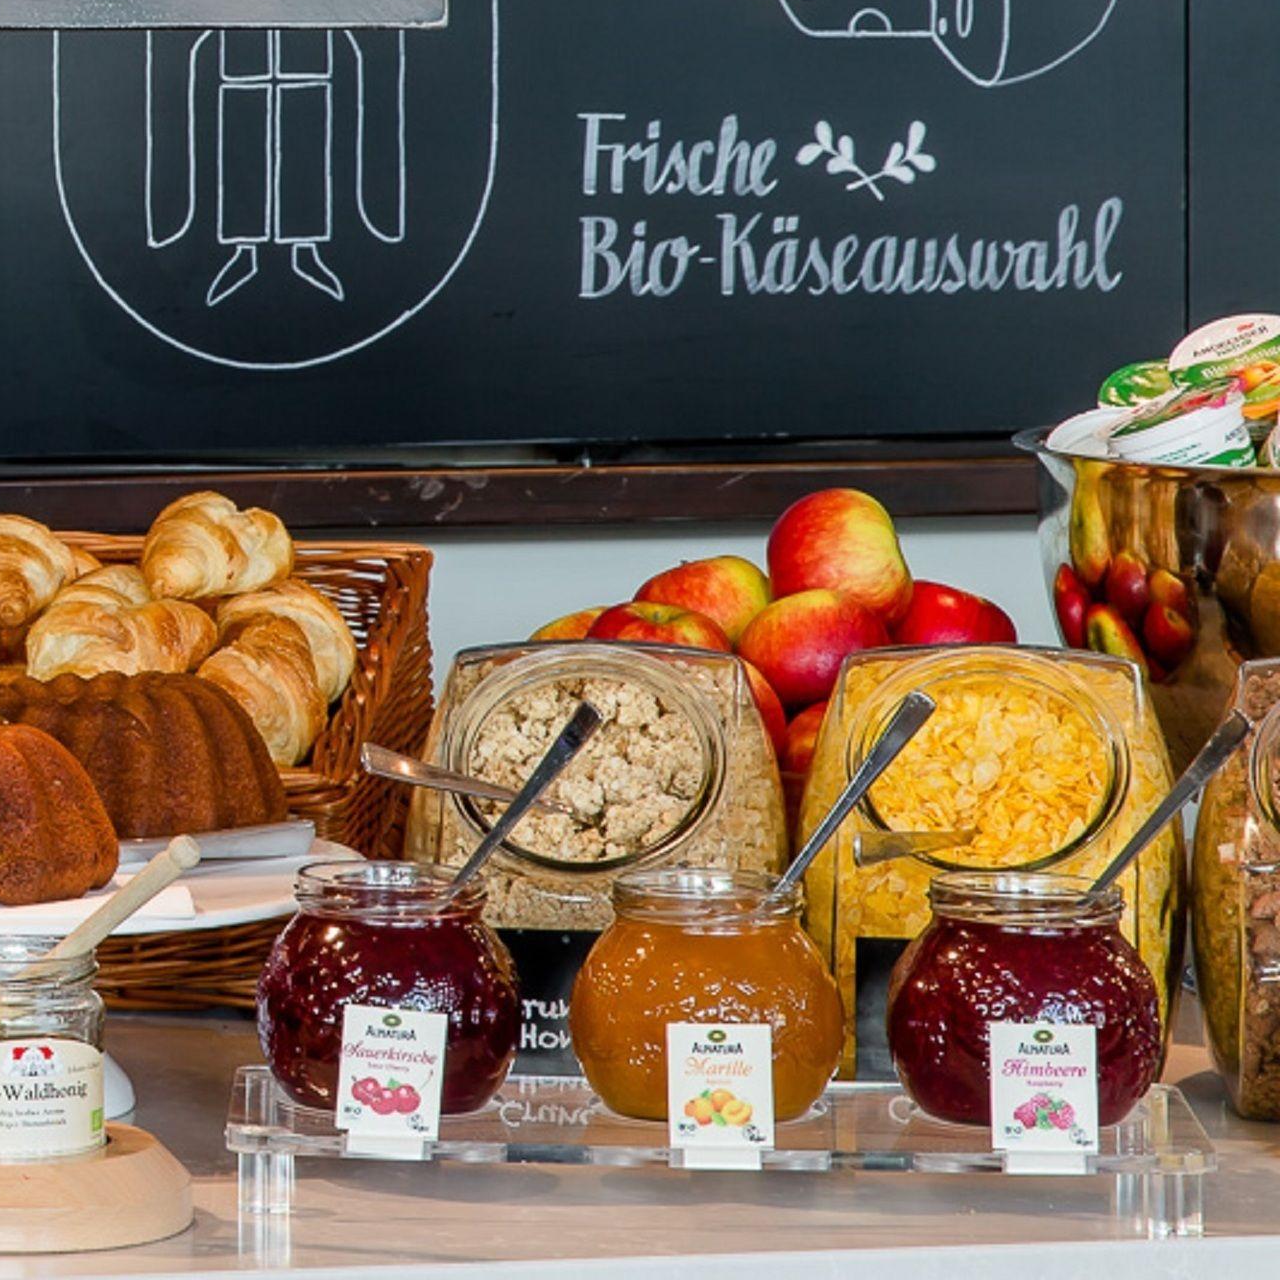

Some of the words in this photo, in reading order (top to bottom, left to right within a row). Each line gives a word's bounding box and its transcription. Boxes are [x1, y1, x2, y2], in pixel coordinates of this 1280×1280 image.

[577, 113, 777, 196] Frische
[578, 197, 1124, 298] Bio-Käseauswahl
[1002, 1059, 1088, 1078] Himbeere
